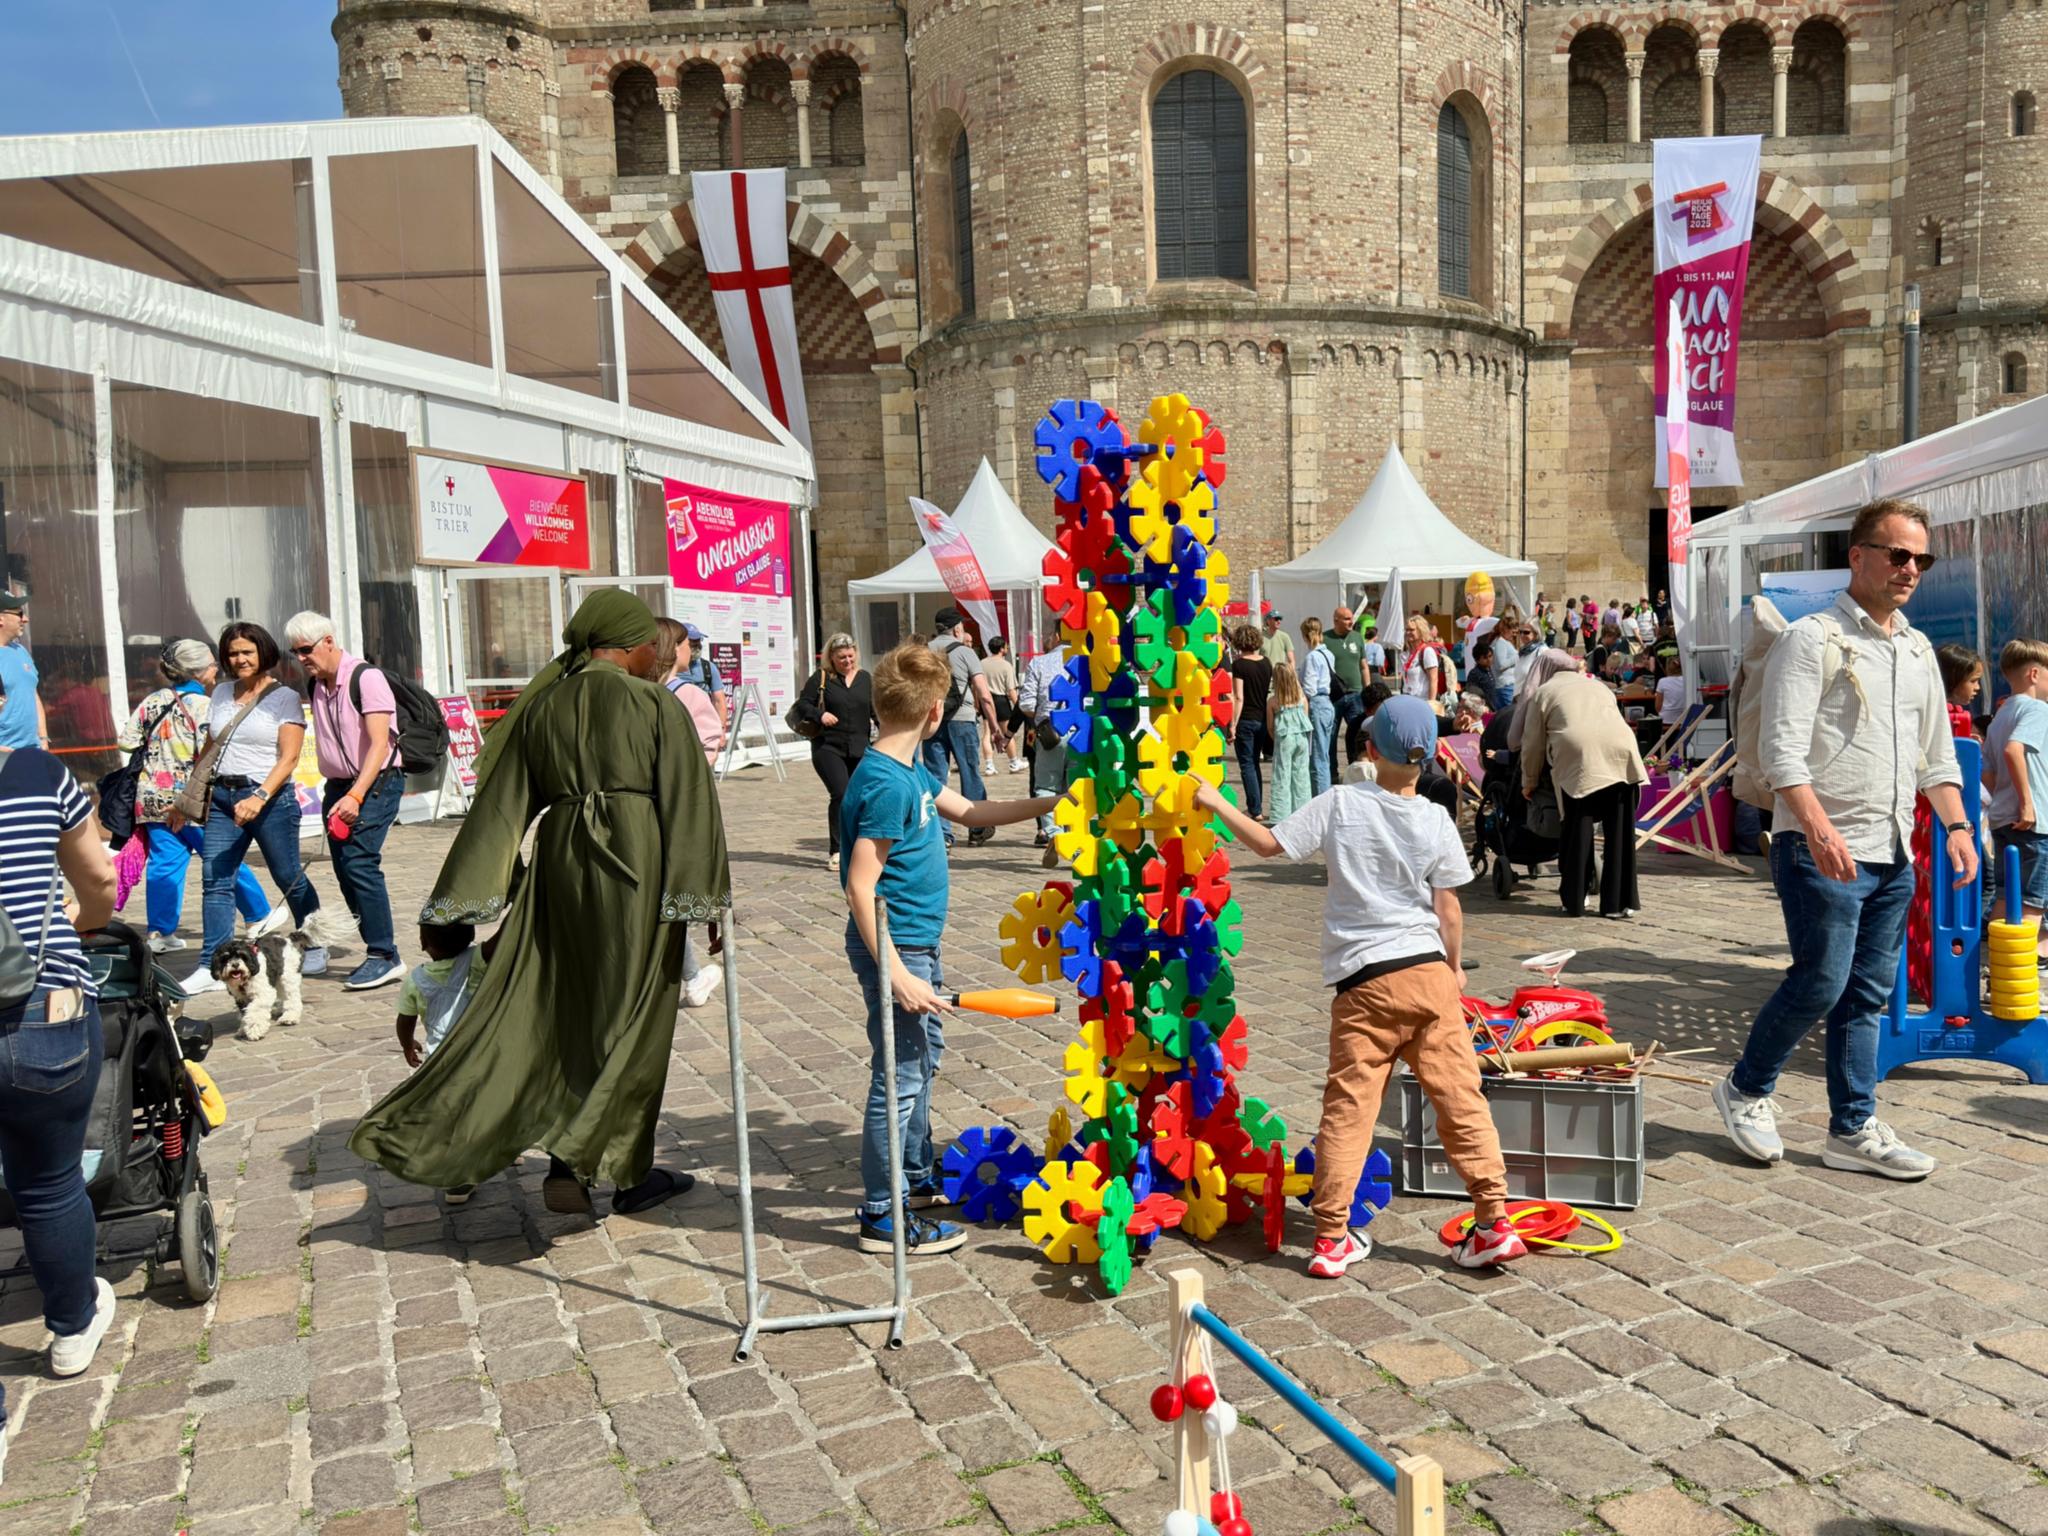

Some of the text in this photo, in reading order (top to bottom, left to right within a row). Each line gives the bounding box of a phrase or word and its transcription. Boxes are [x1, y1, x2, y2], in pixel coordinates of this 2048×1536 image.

[1689, 220, 1712, 228] 2025
[1690, 212, 1712, 220] TAGE
[1683, 273, 1699, 282] BIS
[1701, 272, 1715, 281] 11.
[1716, 271, 1735, 280] MAI
[430, 500, 472, 517] BISTUM
[529, 499, 569, 516] BIENVENUE
[696, 501, 734, 520] ABENDLOB
[435, 517, 470, 533] TRIER
[524, 513, 575, 531] WILLKOMMEN
[532, 529, 569, 544] WELCOME
[735, 569, 749, 586] ICH
